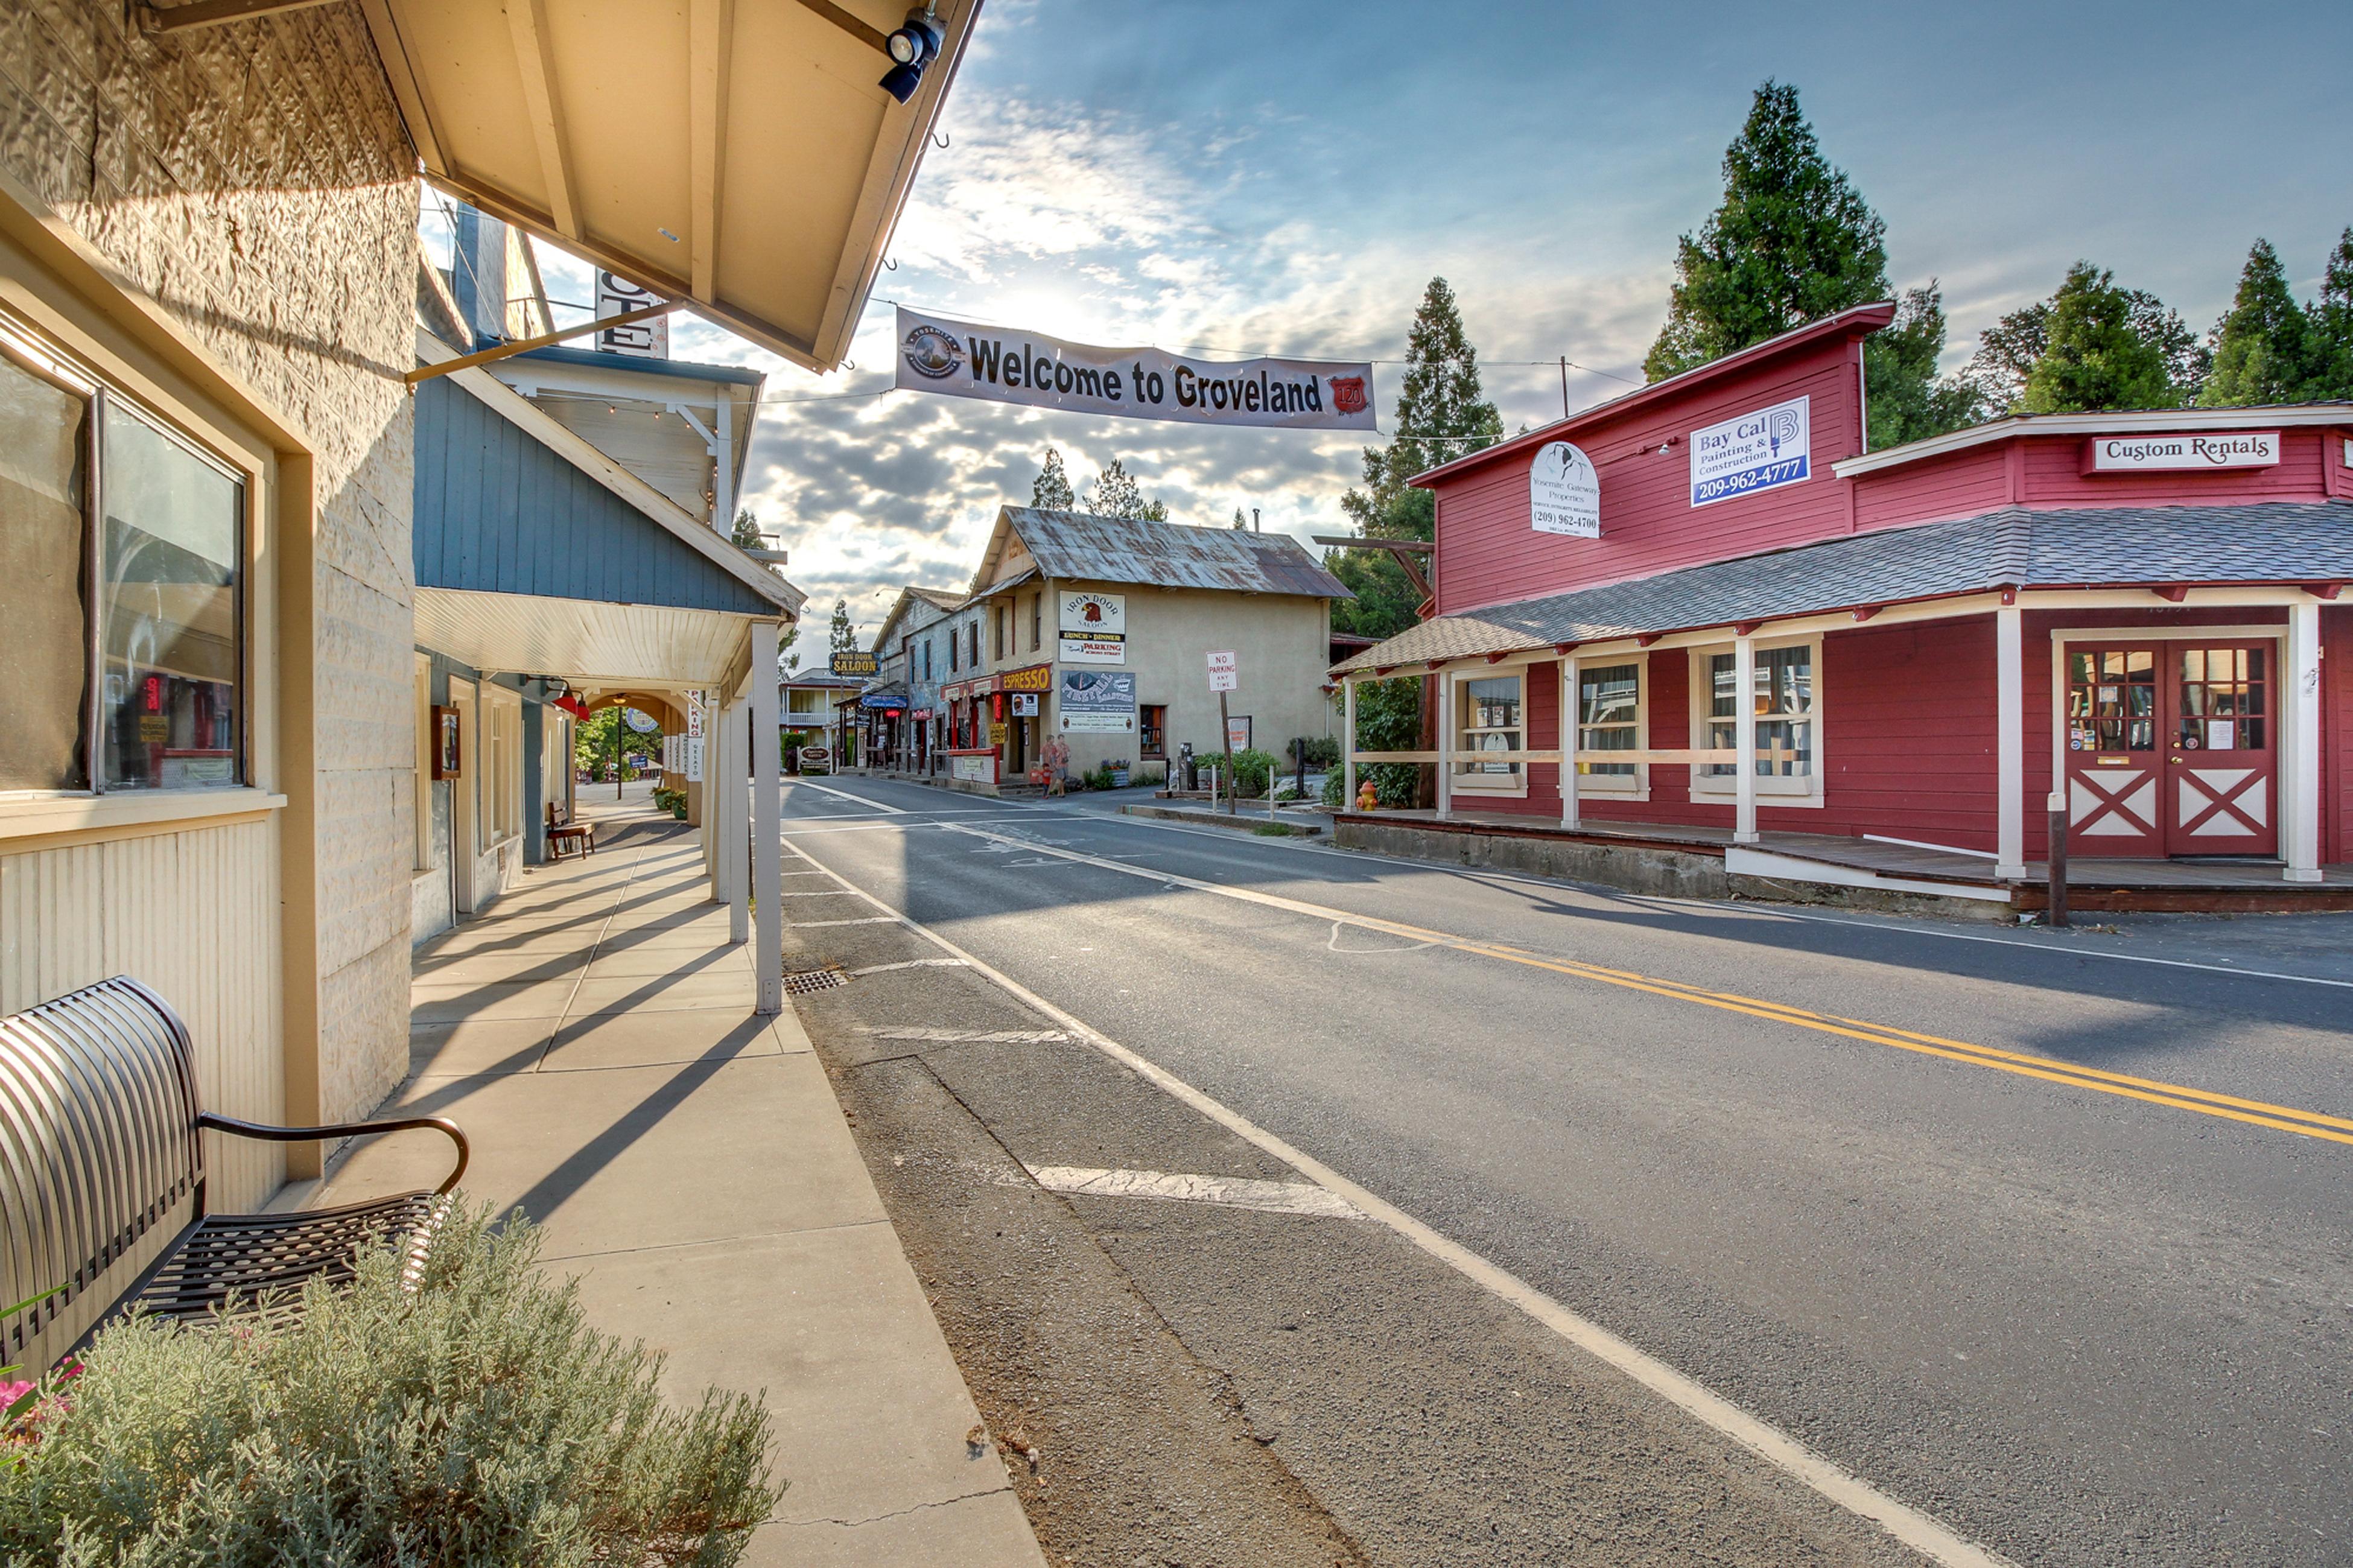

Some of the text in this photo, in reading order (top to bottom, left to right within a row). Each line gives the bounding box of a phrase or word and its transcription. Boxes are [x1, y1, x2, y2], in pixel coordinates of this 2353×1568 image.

[914, 328, 953, 341] YOSEMITE
[969, 337, 1323, 413] Welcome to Groveland
[1339, 387, 1362, 405] 120
[1700, 417, 1767, 451] Bay Cal
[1701, 438, 1767, 465] Painting &
[2106, 437, 2269, 464] Custom Rentals
[1700, 451, 1767, 475] Construction
[1533, 477, 1598, 496] Yosemite Gateway
[1699, 459, 1801, 500] 209-962-4777
[1549, 490, 1584, 503] Properties
[1534, 510, 1596, 528] (209) 962-4700
[1067, 594, 1119, 615] IRON DOOR
[833, 661, 877, 671] SALOON
[1209, 665, 1235, 674] PARKING
[1003, 667, 1049, 689] ESPRESSO
